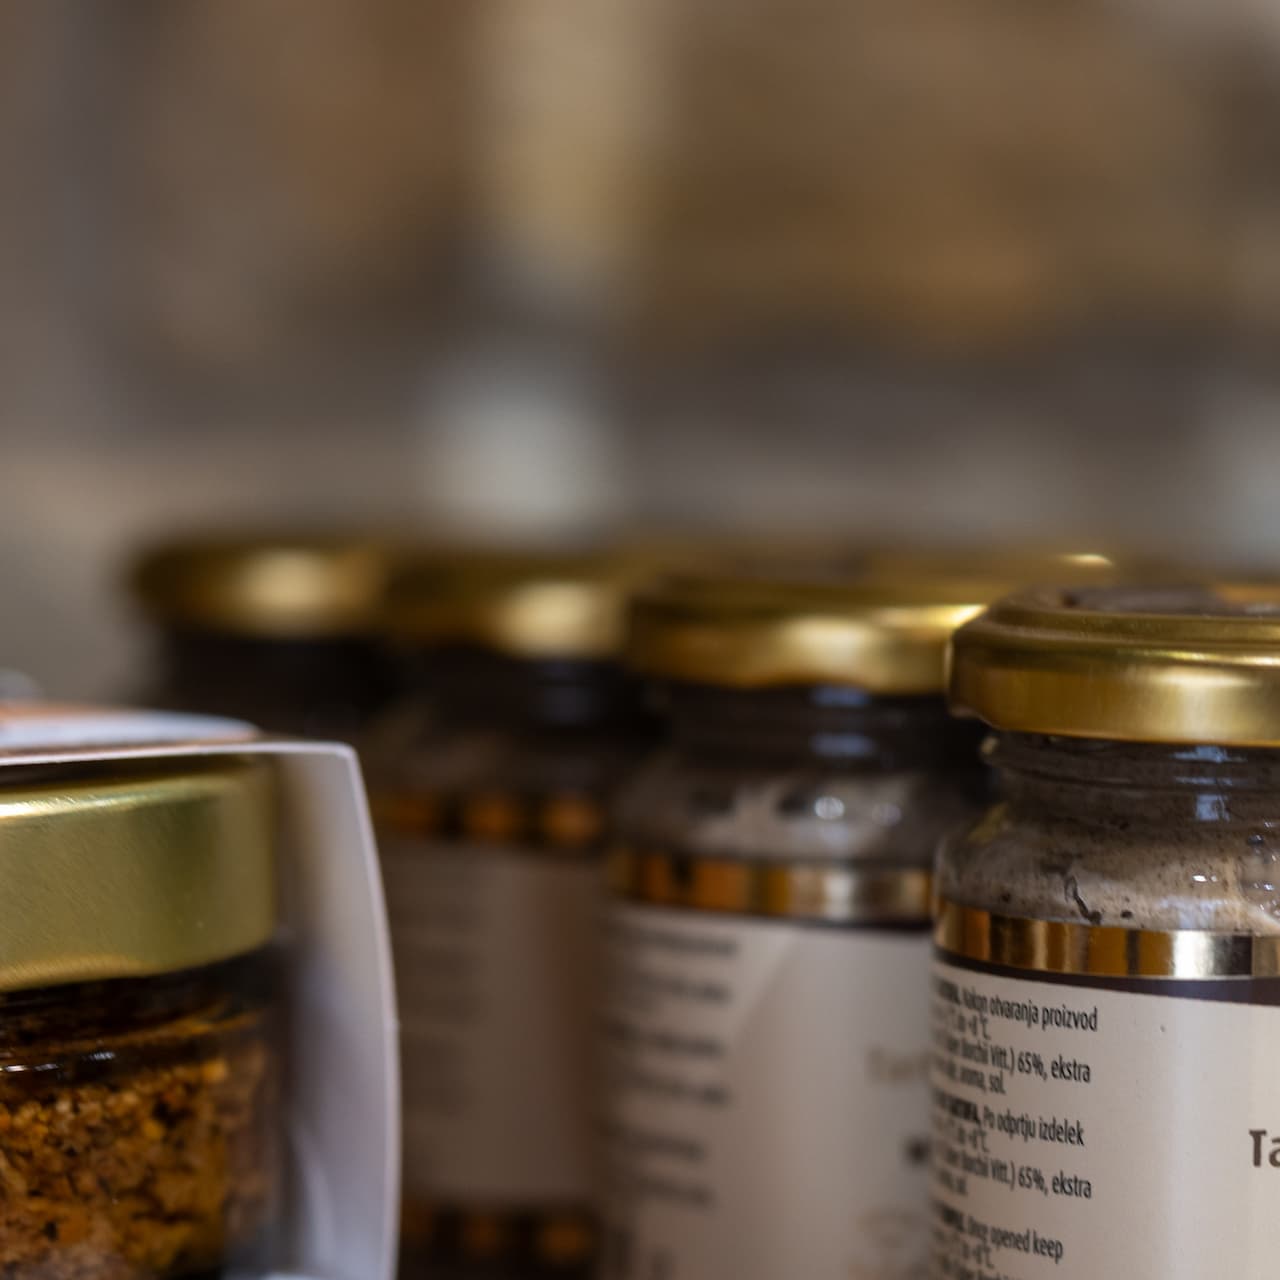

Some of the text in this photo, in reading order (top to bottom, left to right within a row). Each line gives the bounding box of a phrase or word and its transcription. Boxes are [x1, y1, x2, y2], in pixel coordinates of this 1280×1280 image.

[1042, 1002, 1098, 1032] proizvod
[1018, 1051, 1048, 1081] 65%,
[1051, 1054, 1091, 1083] ekstra
[1039, 1115, 1085, 1146] izdelek
[1018, 1165, 1048, 1196] 65%,
[1052, 1169, 1093, 1199] ekstra
[1033, 1229, 1063, 1265] keep
